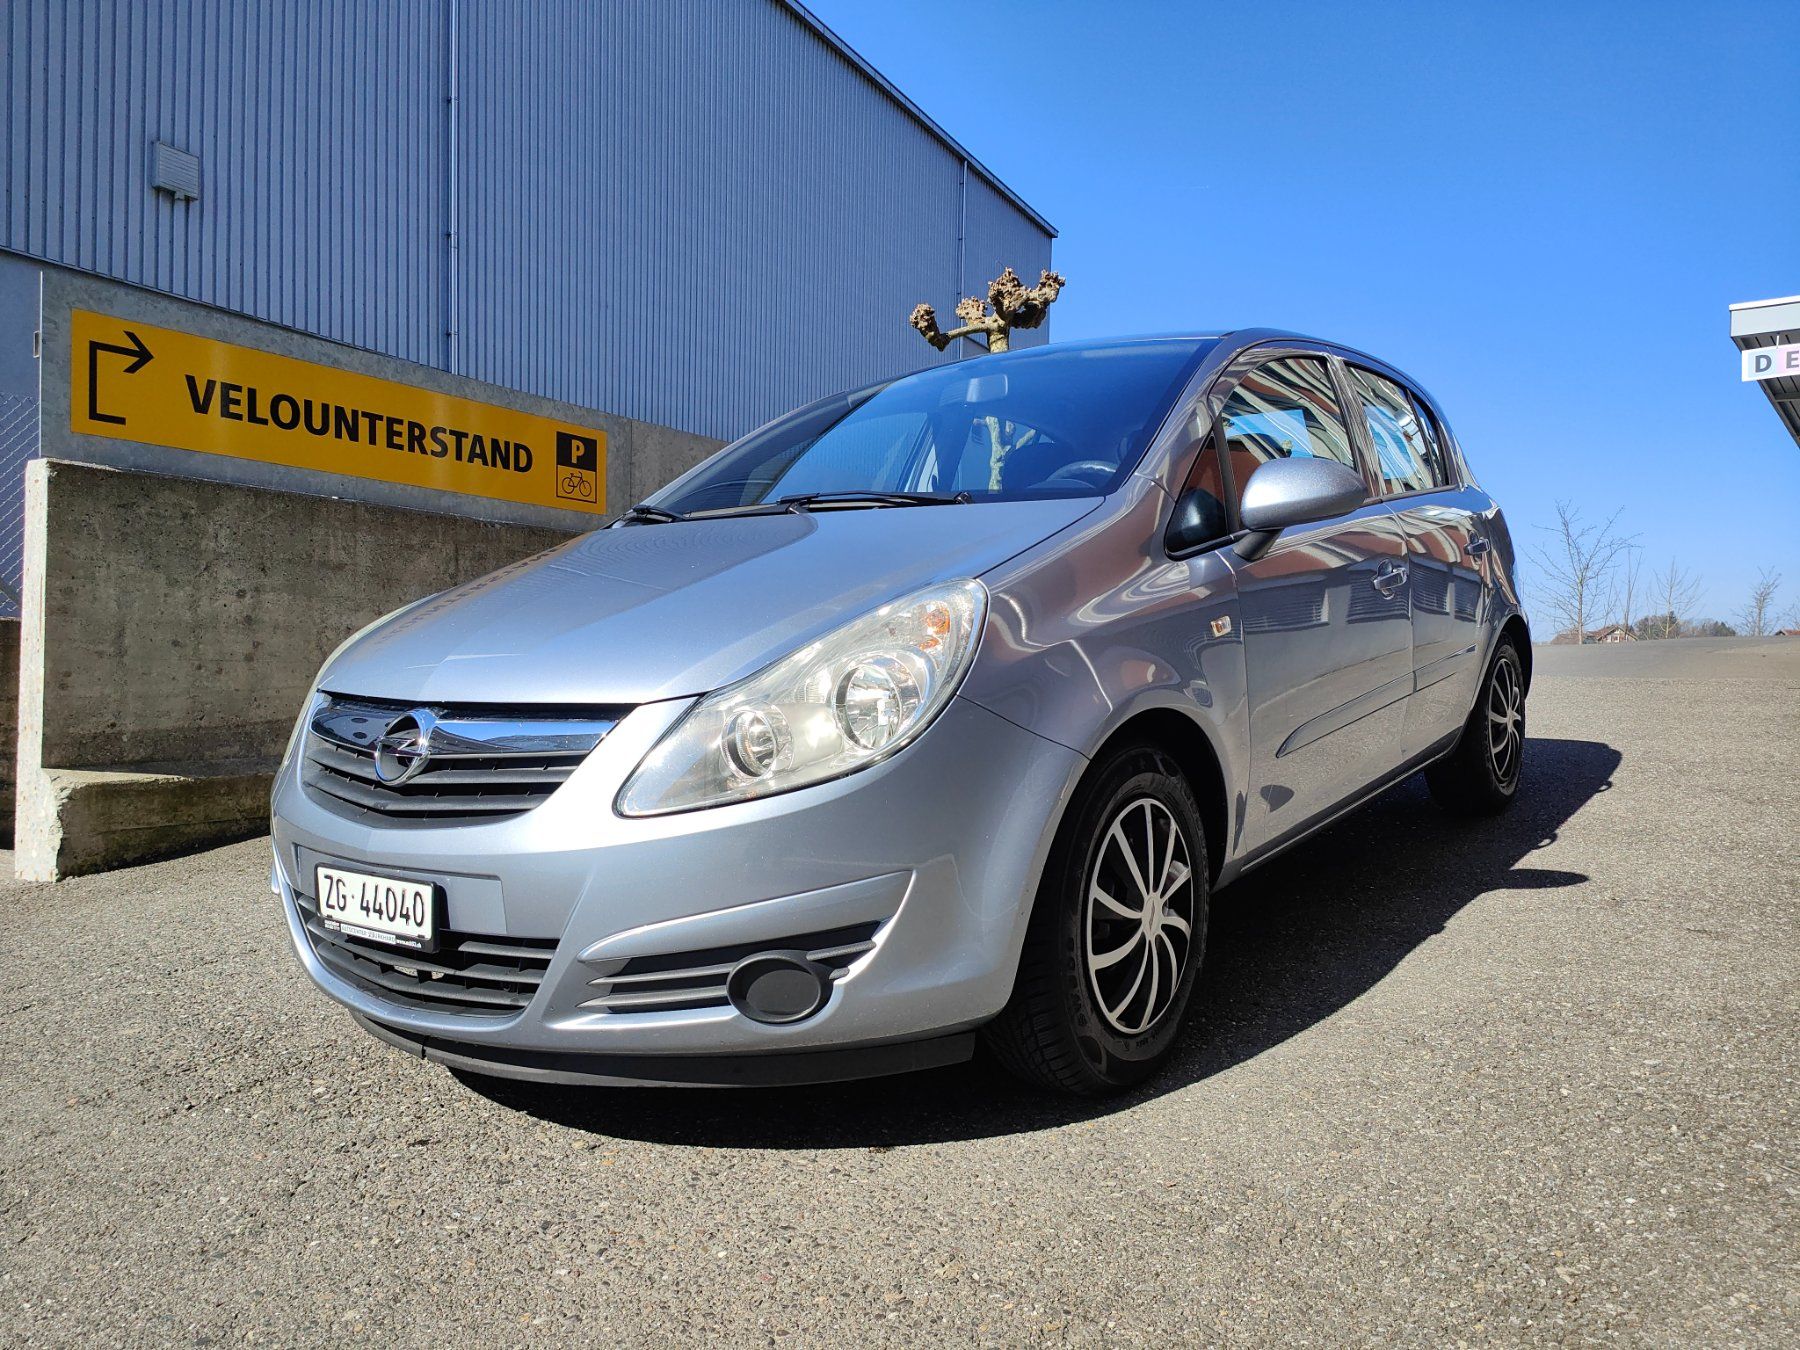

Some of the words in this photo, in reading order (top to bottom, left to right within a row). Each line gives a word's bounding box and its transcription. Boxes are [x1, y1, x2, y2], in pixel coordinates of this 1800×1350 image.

[185, 374, 533, 473] VELOUNTERSTAND
[571, 437, 585, 464] P
[324, 874, 347, 911] ZG
[360, 882, 425, 927] 44040
